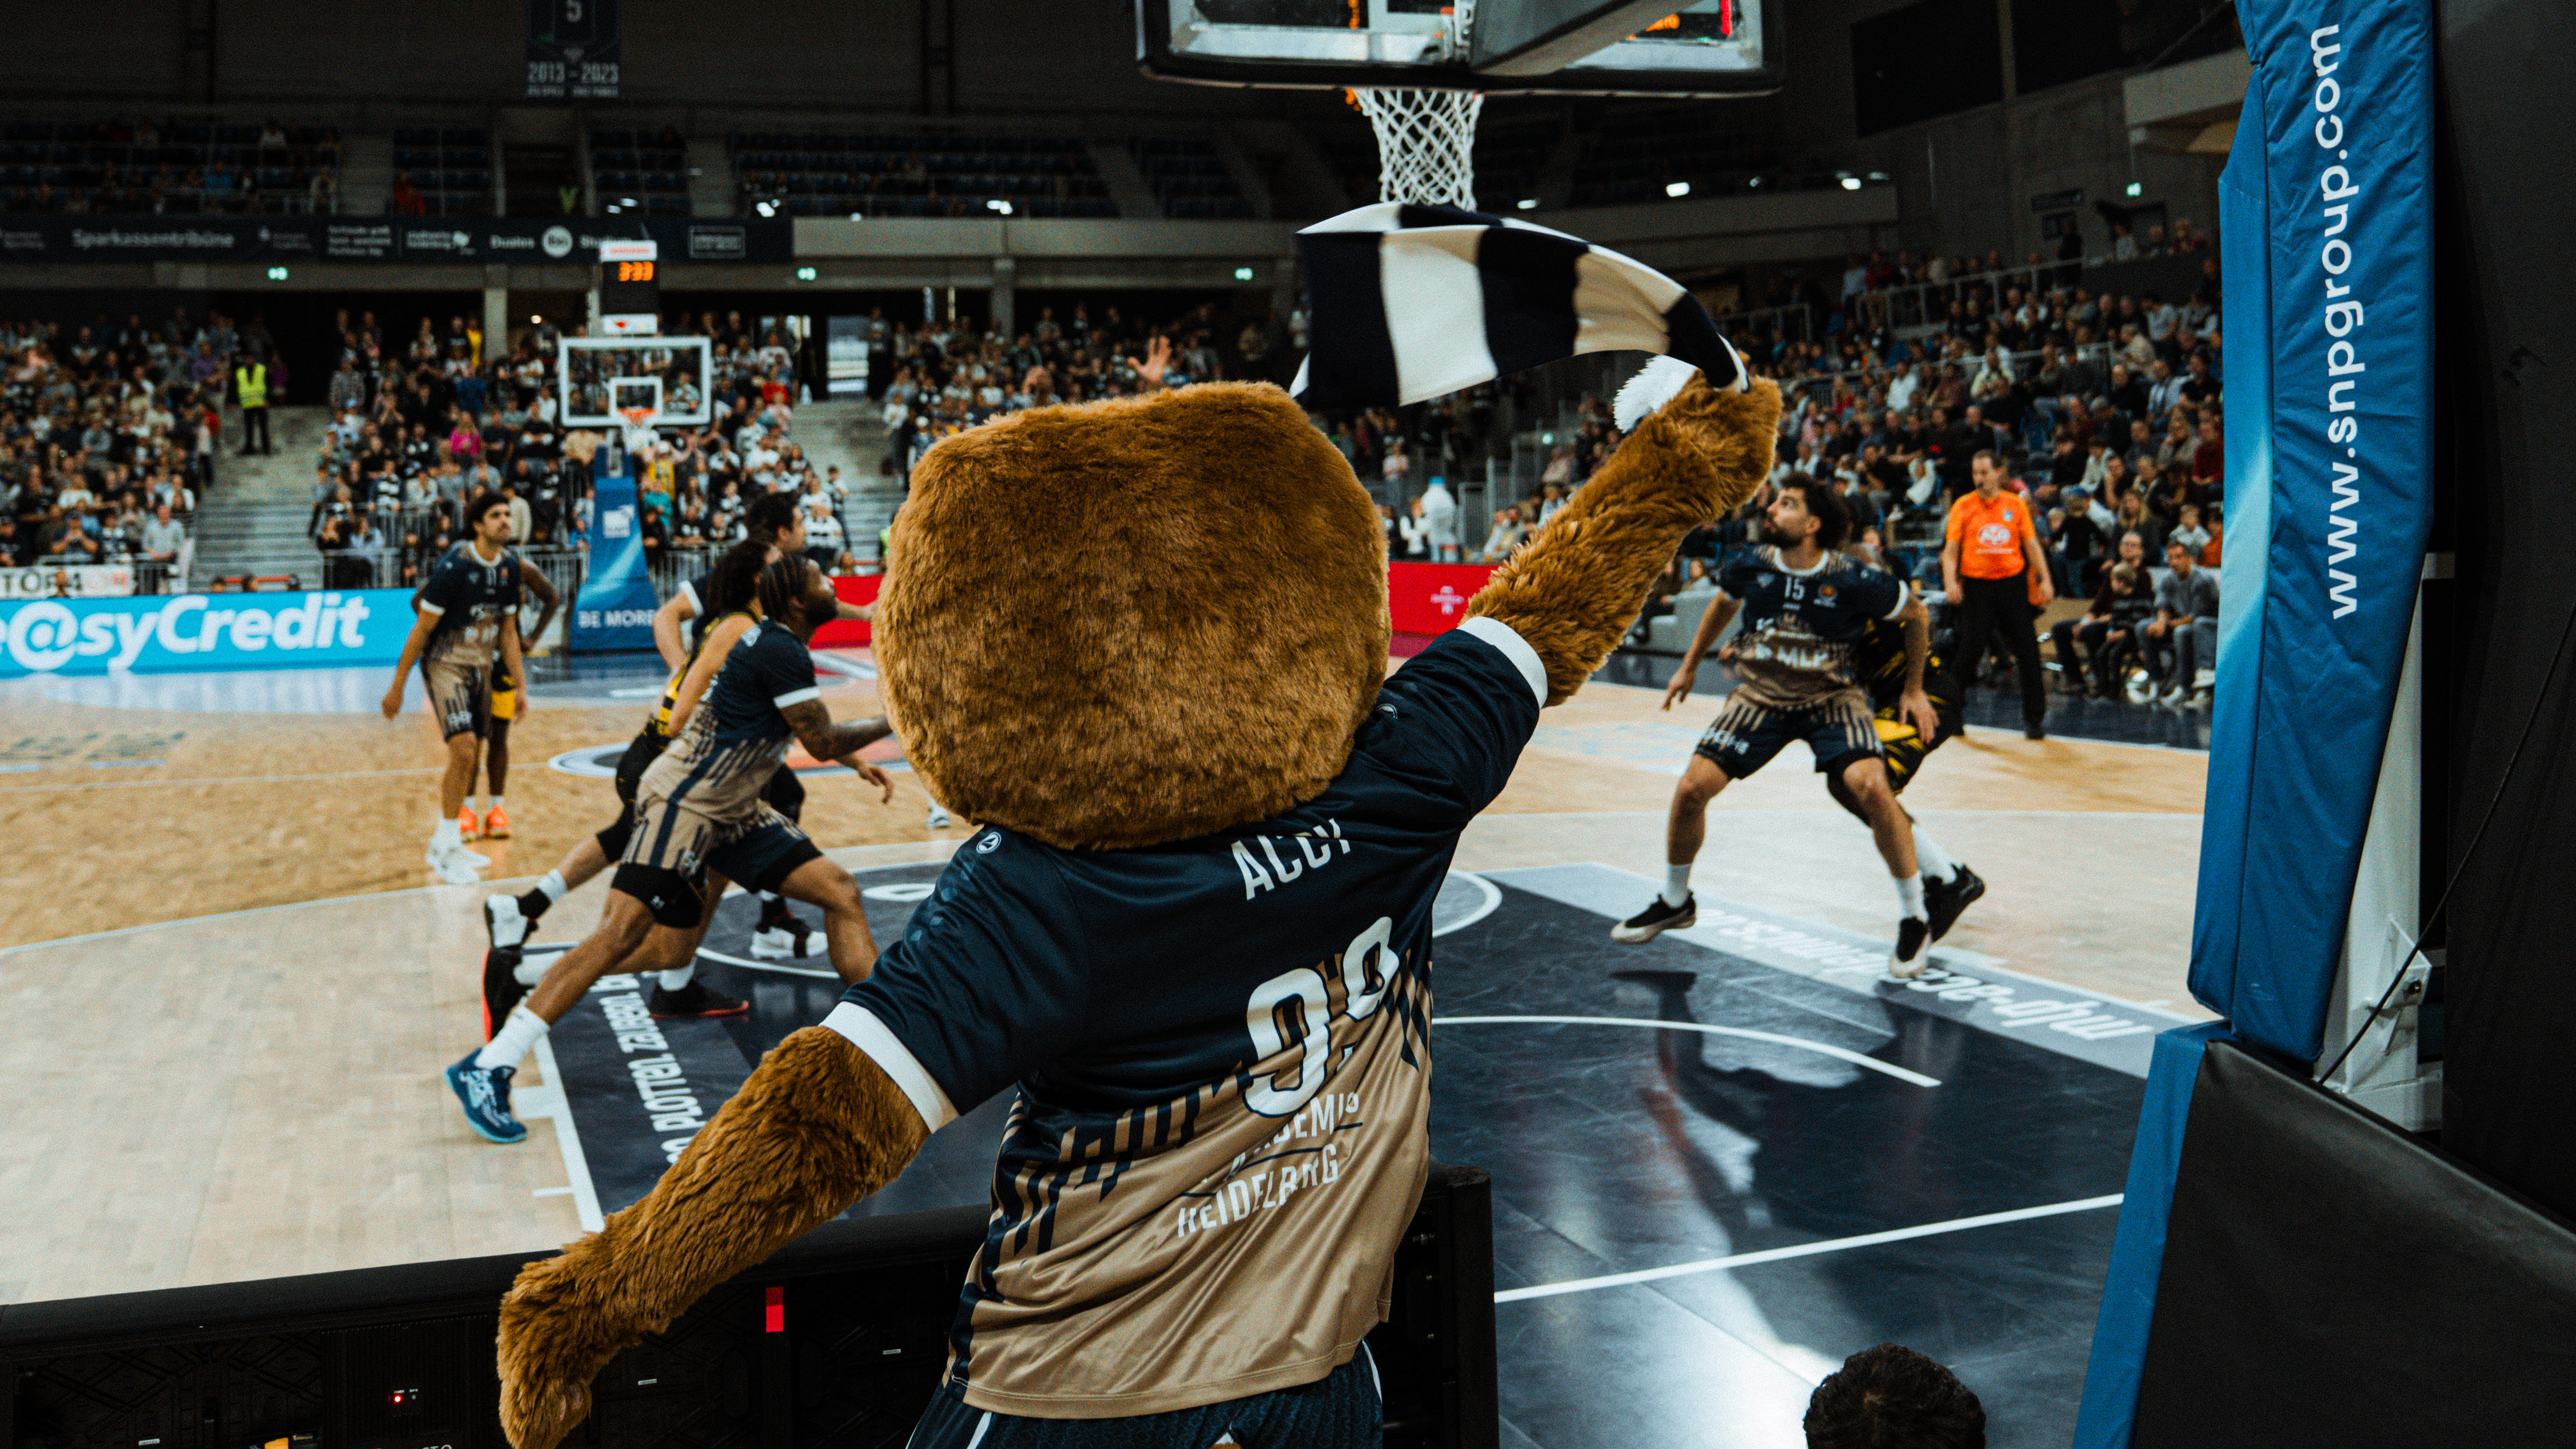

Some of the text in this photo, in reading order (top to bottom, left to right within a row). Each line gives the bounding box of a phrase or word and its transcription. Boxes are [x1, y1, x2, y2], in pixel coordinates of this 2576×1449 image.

[566, 0, 582, 22] 5
[2310, 24, 2366, 620] www.snpgroup.com
[1783, 576, 1806, 600] 15
[578, 609, 657, 628] BE MORE
[1231, 818, 1351, 901] ACCY
